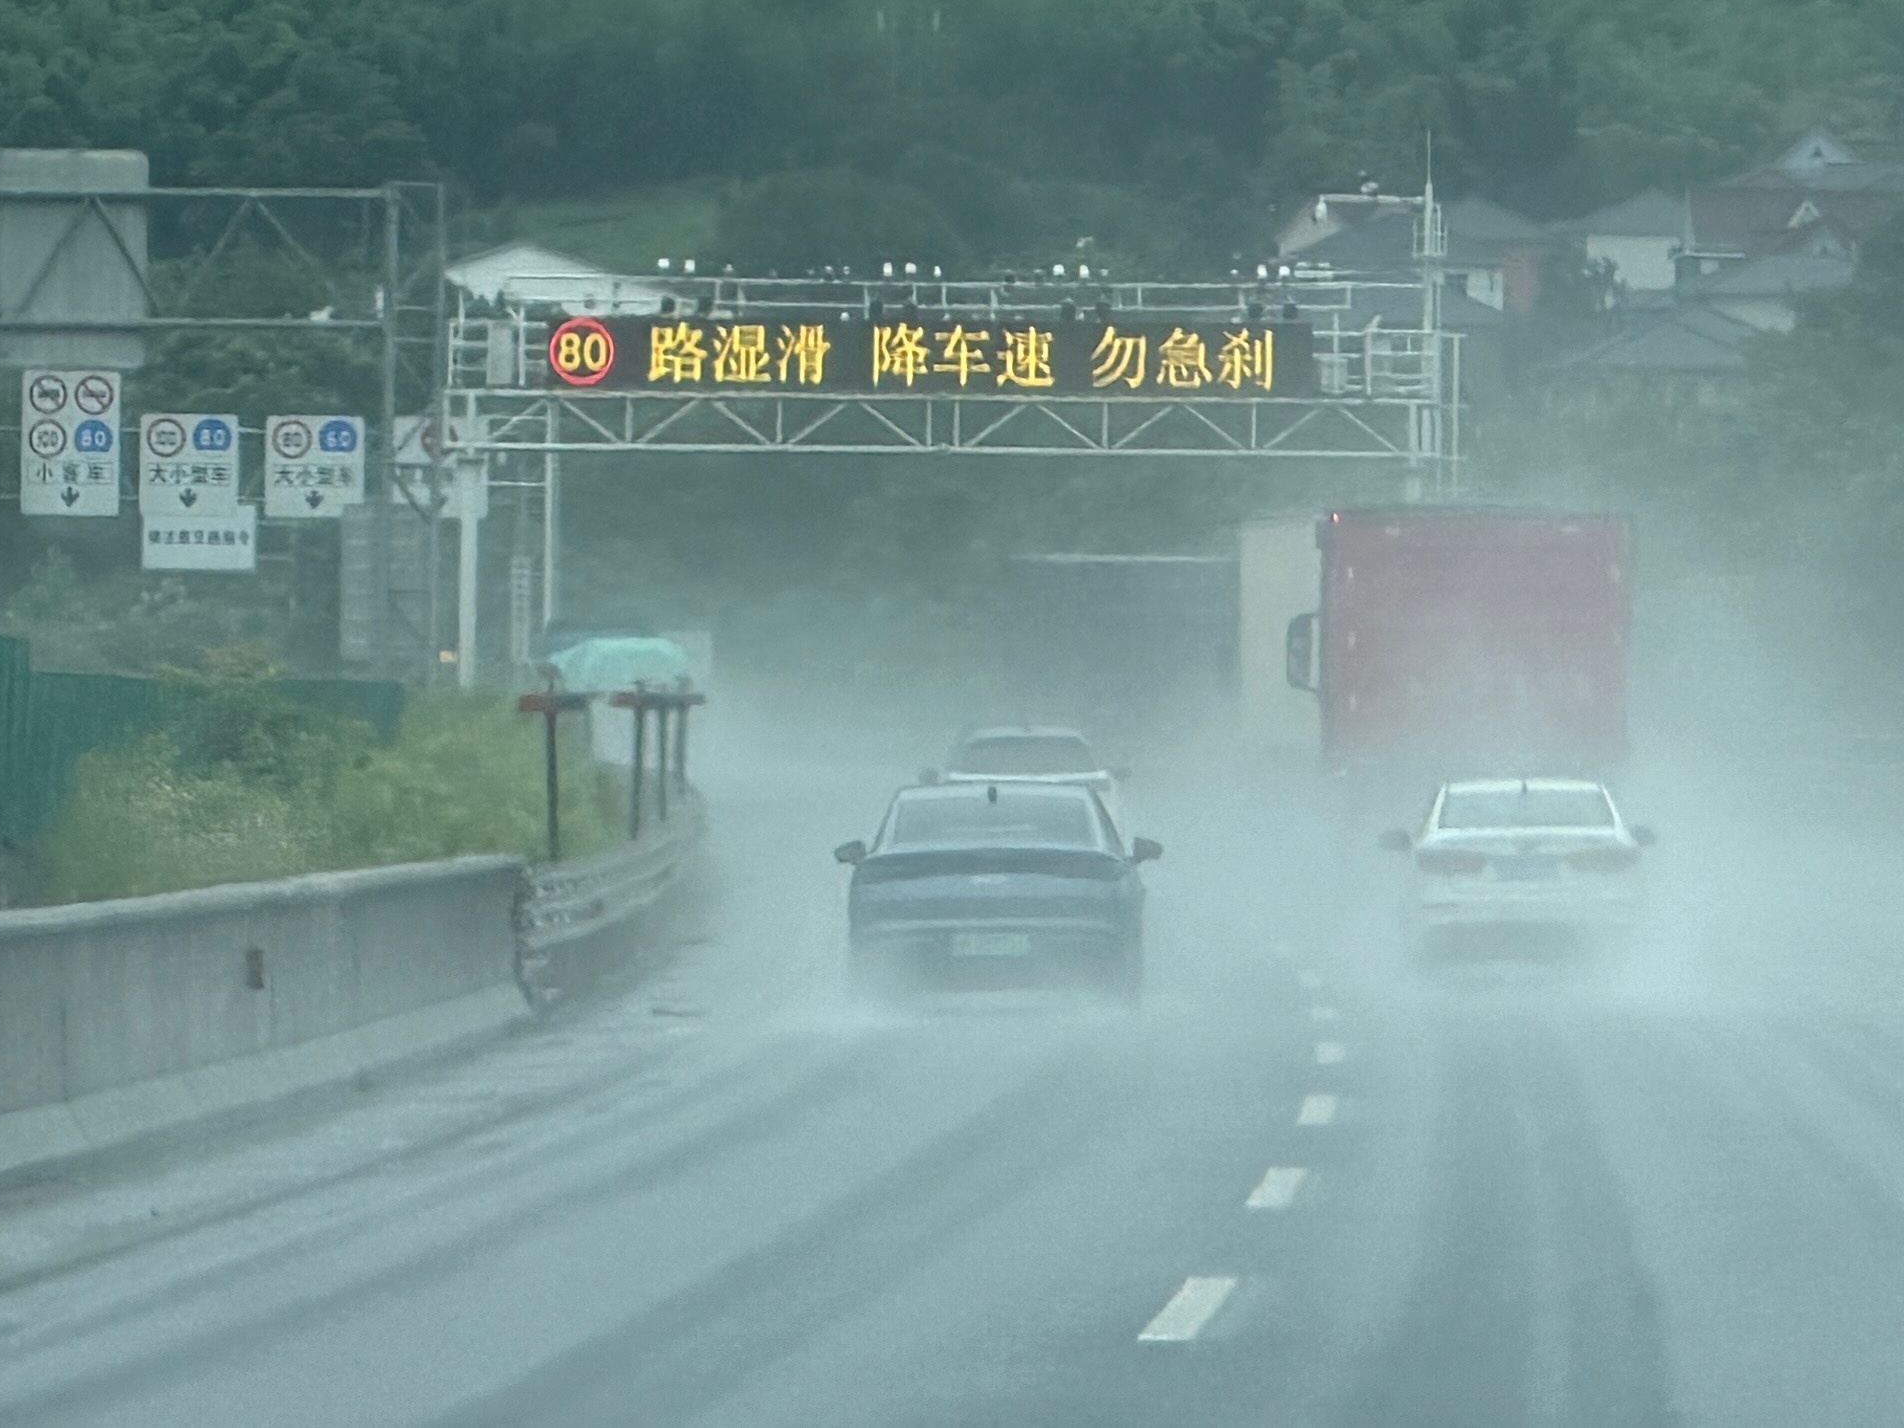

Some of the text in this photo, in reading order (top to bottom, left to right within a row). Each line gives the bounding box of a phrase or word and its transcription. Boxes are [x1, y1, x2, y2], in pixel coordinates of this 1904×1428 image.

[559, 322, 1274, 390] 80 路湿滑 降车速 勿急刹
[81, 429, 106, 447] 80
[200, 429, 225, 446] 80
[149, 464, 230, 484] 大小型车
